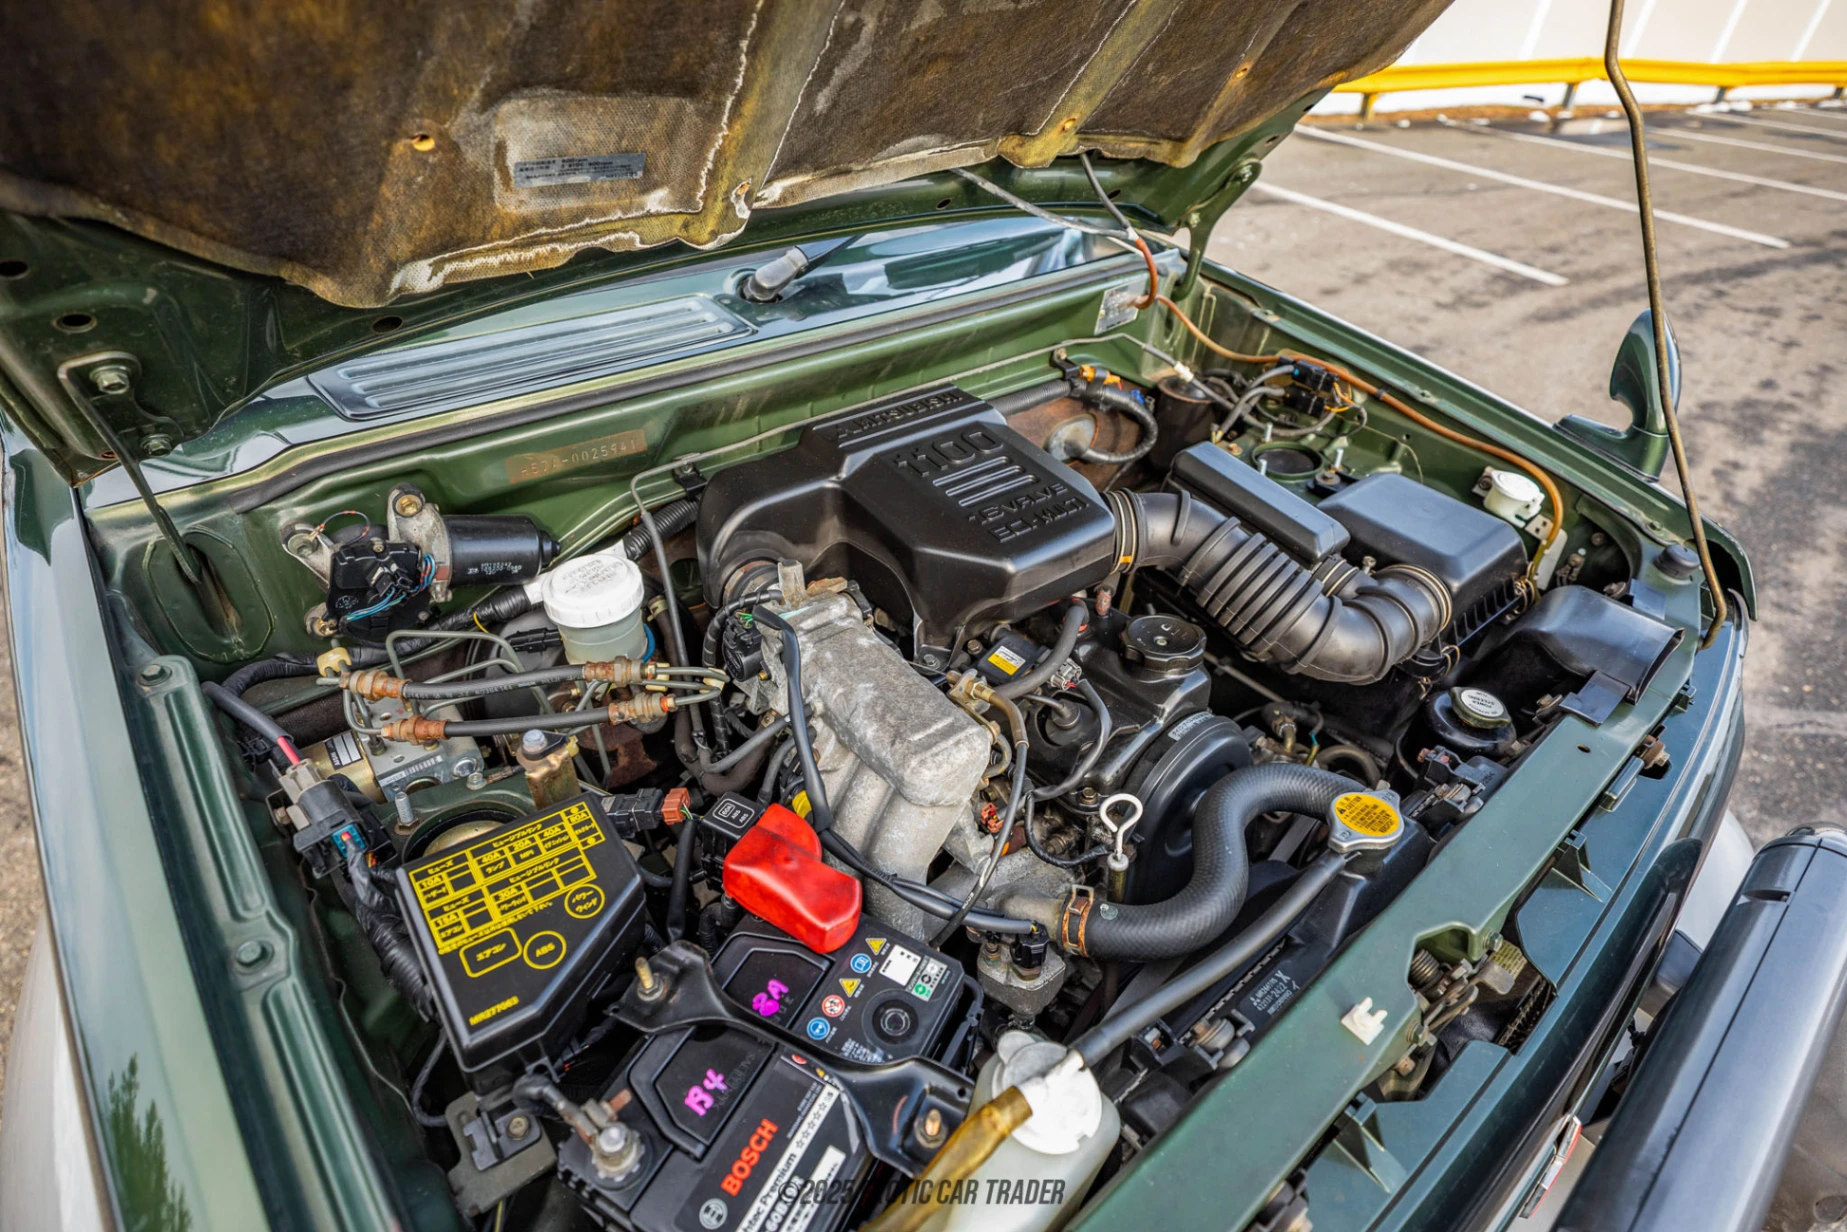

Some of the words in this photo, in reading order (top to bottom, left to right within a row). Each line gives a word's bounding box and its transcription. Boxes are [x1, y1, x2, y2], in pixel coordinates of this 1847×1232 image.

[482, 851, 502, 863] 40A
[512, 839, 532, 851] 20A
[542, 826, 562, 838] 40A
[420, 876, 440, 889] 10A
[535, 942, 556, 958] ABS
[720, 1118, 779, 1197] BOSCH
[759, 1152, 798, 1206] Premium
